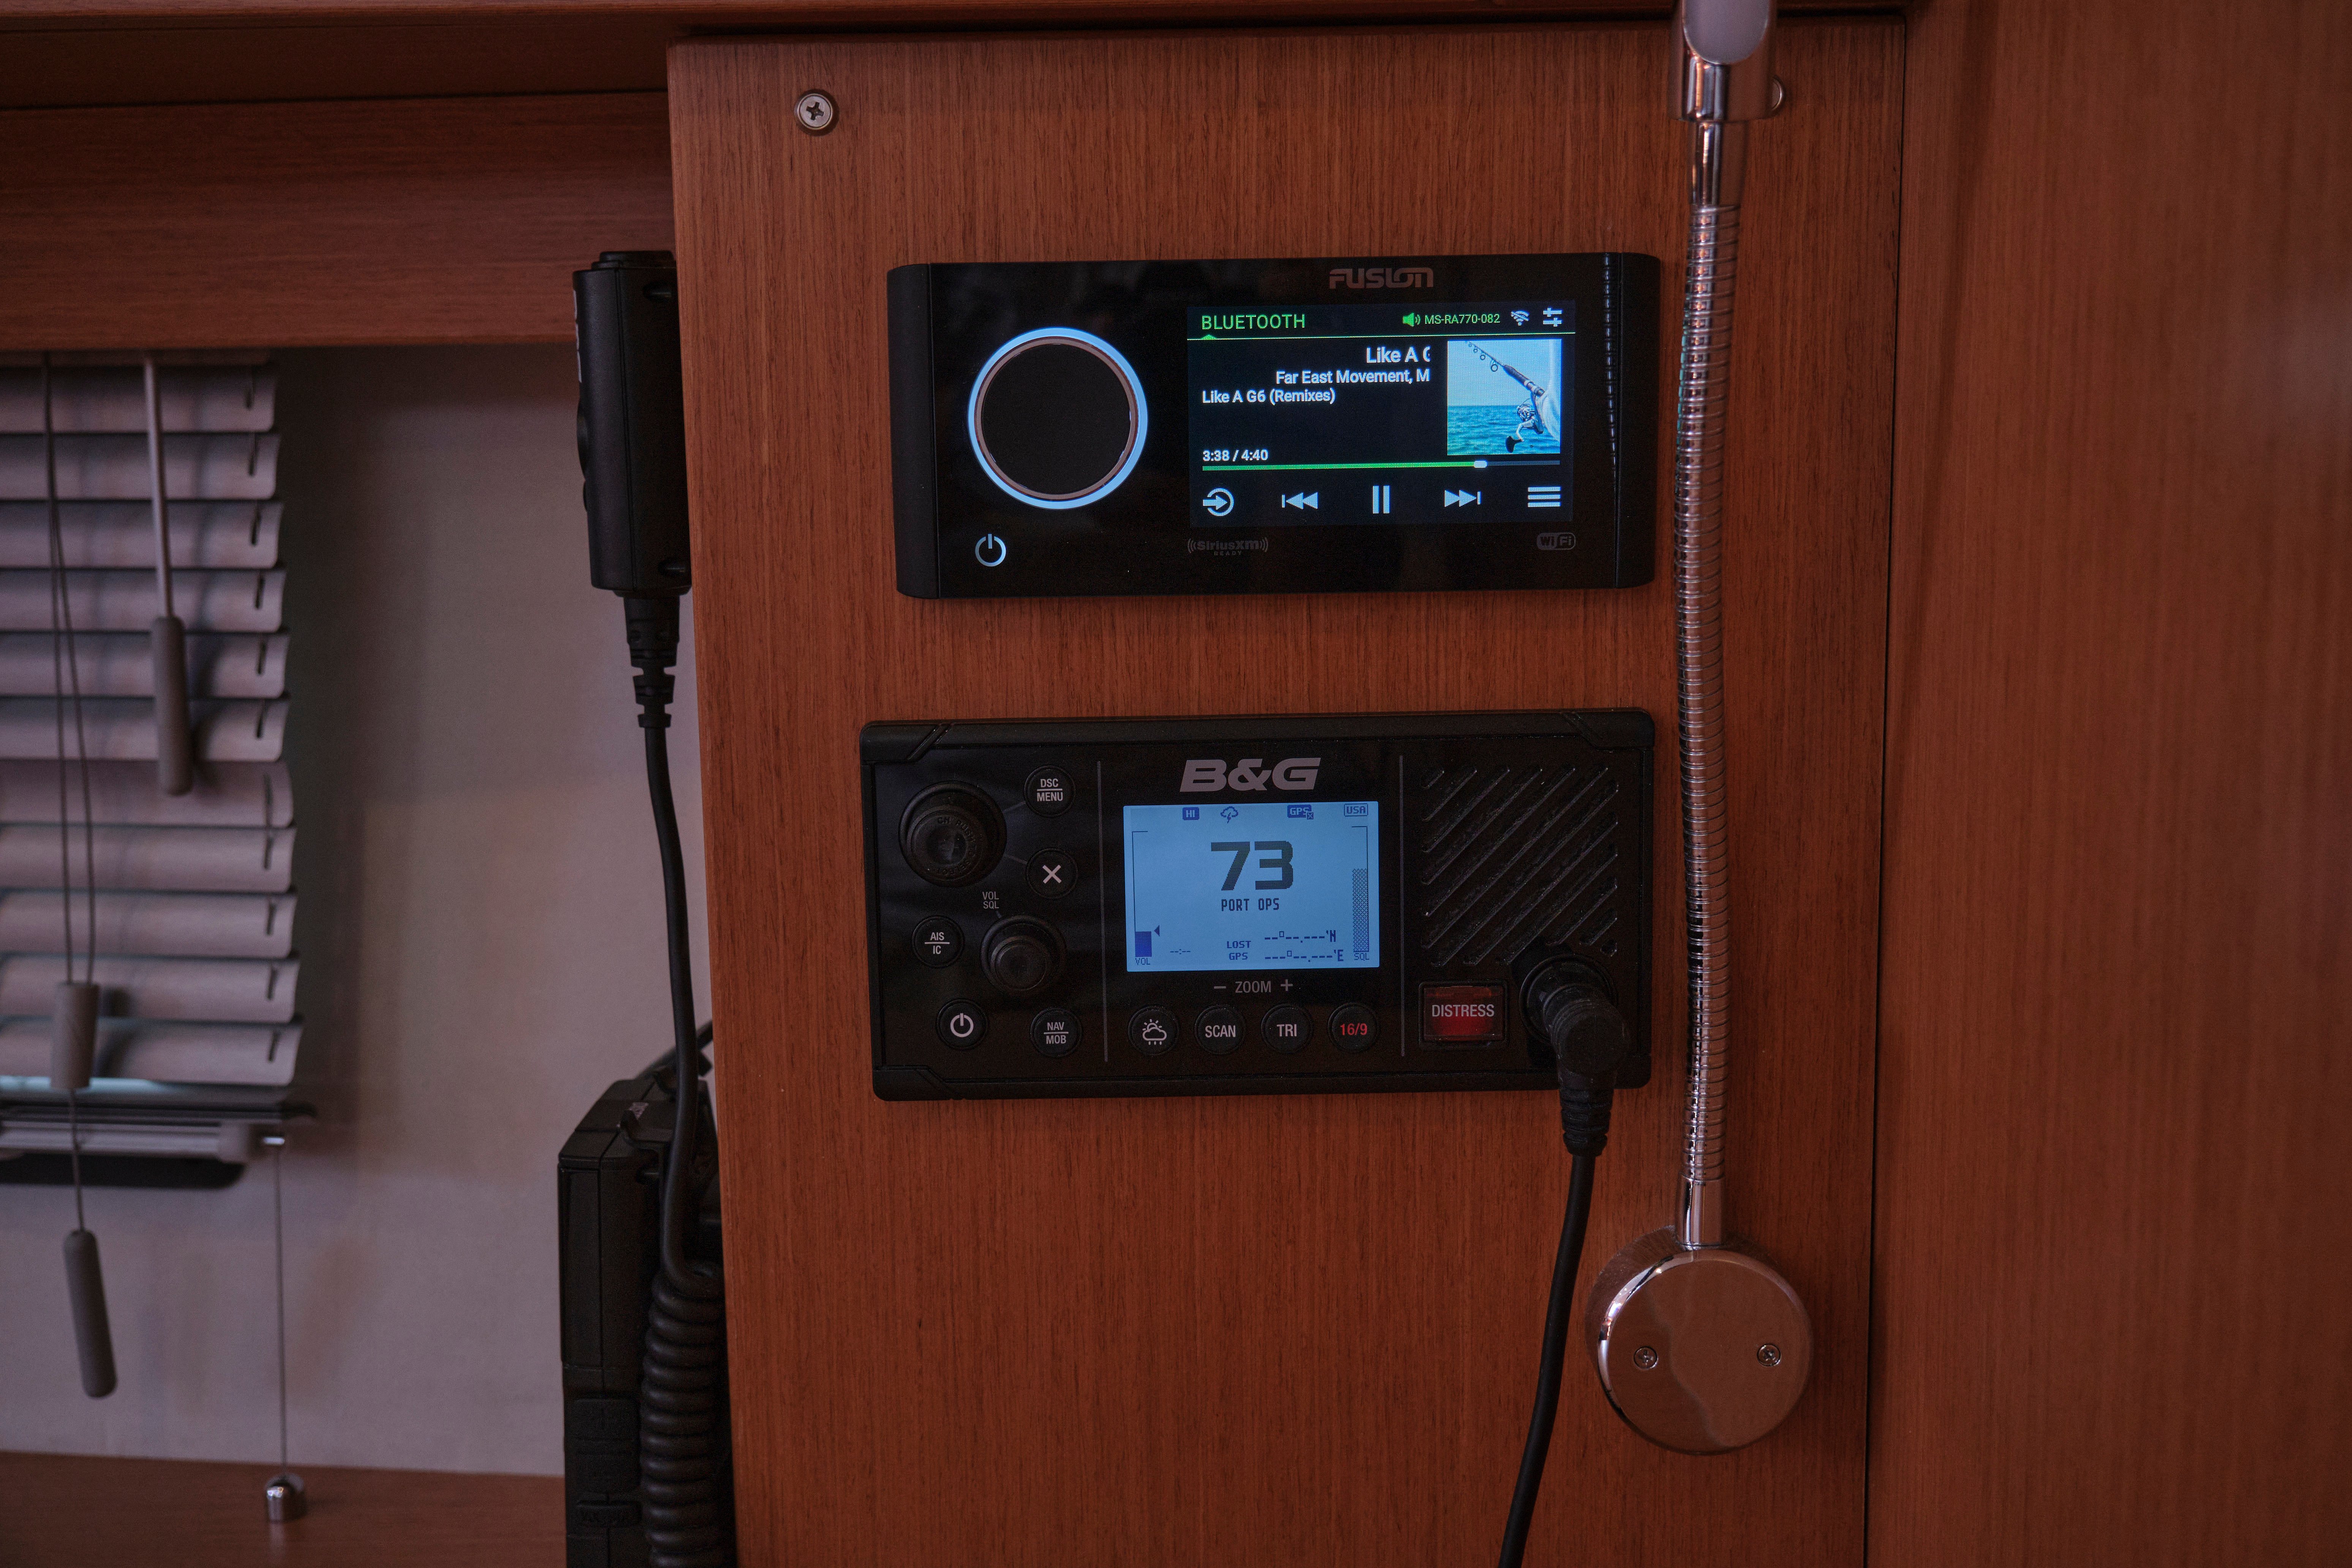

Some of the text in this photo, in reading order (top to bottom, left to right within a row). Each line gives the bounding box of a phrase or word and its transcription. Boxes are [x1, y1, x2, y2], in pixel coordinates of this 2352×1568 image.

[1329, 267, 1434, 289] FUSION
[1202, 314, 1305, 330] BLUETOOTH
[1425, 313, 1500, 324] MS-RA770-082
[1366, 346, 1402, 363] Like
[1405, 346, 1419, 362] A
[1276, 368, 1430, 384] Far East Movement, M
[1202, 387, 1336, 405] Like A G6 (Remixes)
[1203, 448, 1269, 462] 3:38 / 4:40
[1179, 757, 1321, 792] B&G
[1040, 778, 1059, 788] DSC
[1037, 792, 1064, 802] MENU
[1185, 809, 1196, 818] HI
[1211, 840, 1294, 891] 73
[982, 891, 999, 900] VOL
[983, 901, 999, 909] SQL
[1221, 898, 1280, 912] PORT OPS
[930, 932, 945, 941] AIS
[933, 945, 942, 955] IC
[1227, 940, 1252, 949] LOST
[1229, 952, 1248, 961] GPS
[1354, 953, 1370, 961] SQL
[1235, 980, 1272, 993] ZOOM
[1432, 1004, 1494, 1018] DISTRESS
[1046, 1021, 1065, 1031] NAV
[1205, 1024, 1236, 1038] SCAN
[1276, 1024, 1297, 1037] TRI
[1340, 1023, 1368, 1036] 16/9
[1046, 1034, 1067, 1045] MOB
